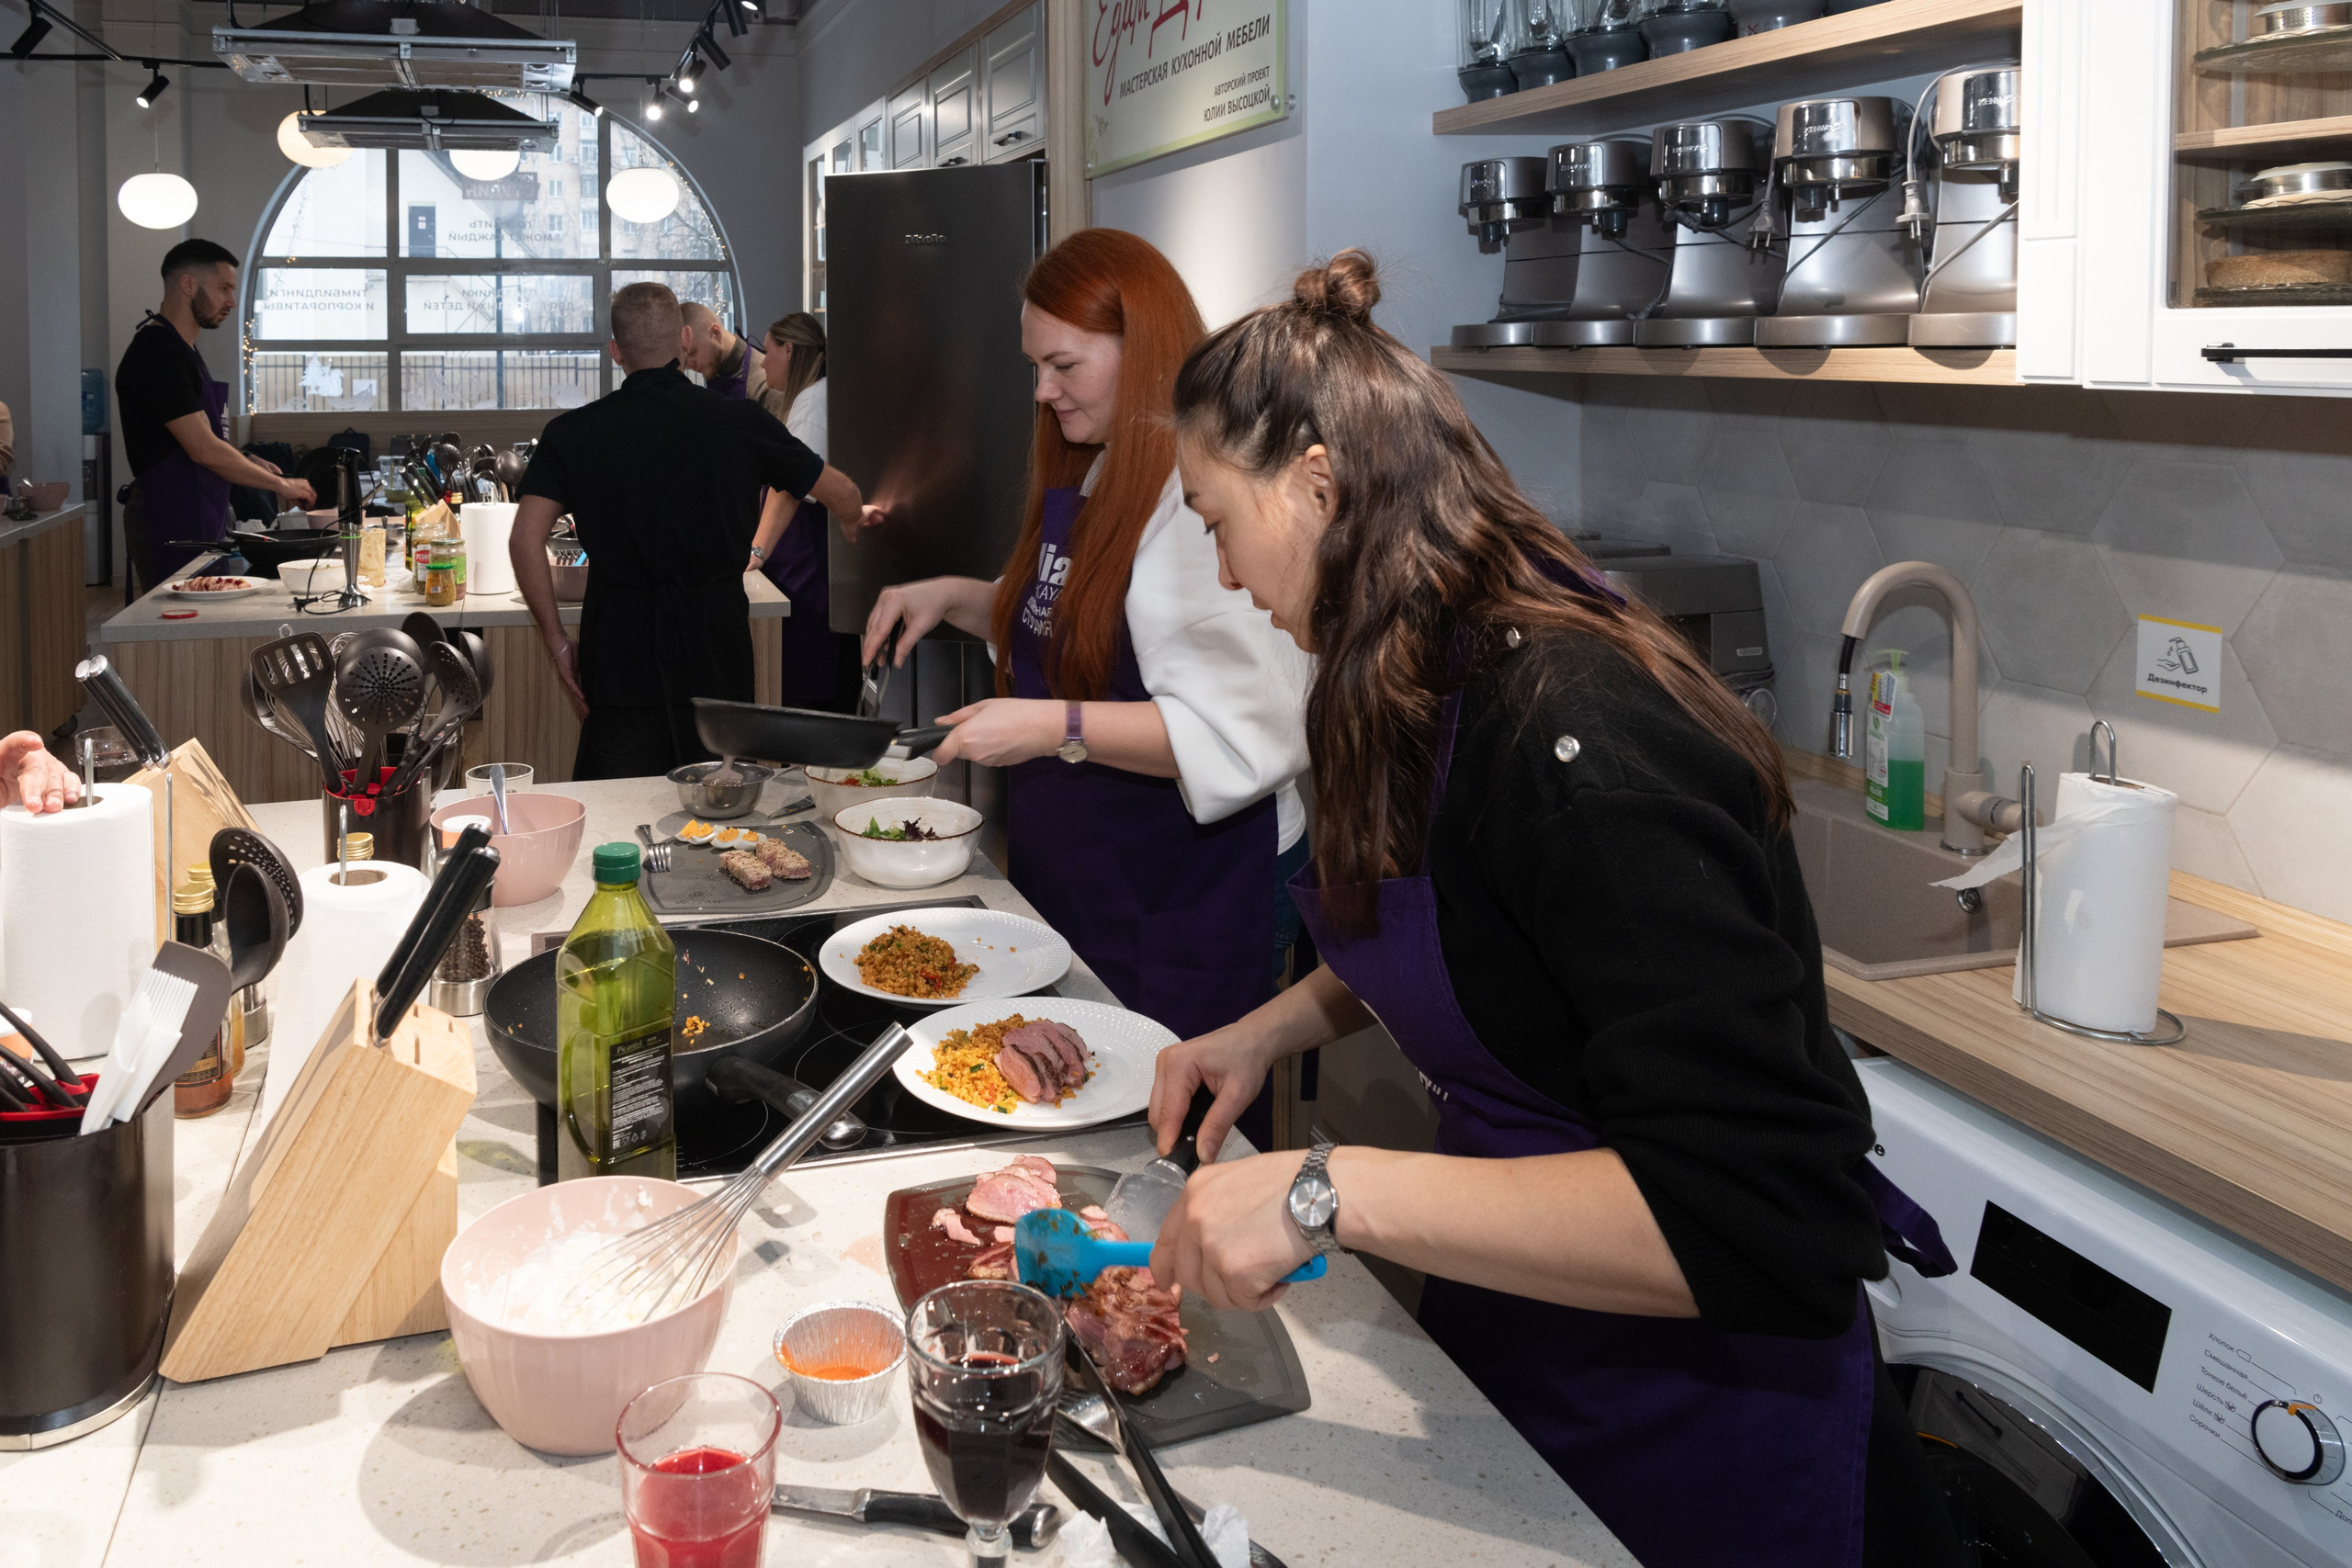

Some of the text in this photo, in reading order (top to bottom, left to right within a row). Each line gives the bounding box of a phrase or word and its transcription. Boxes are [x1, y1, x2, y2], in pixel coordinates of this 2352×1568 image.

[1120, 61, 1168, 98] МАСТЕРСКАЯ
[1171, 30, 1222, 75] КУХОННОЙ
[1227, 14, 1271, 51] МЕБЕЛИ
[1214, 66, 1271, 96] АВТОРСКИЙ ПРОЕКТ
[1204, 84, 1271, 122] ЮЛИИ ВЫСОЦКОЙ
[2147, 673, 2208, 694] Дезинфектор
[2208, 1332, 2234, 1352] Хлопок
[2204, 1349, 2248, 1380] Смешанная
[2196, 1382, 2224, 1405] Шерсть
[2200, 1366, 2248, 1400] Тонкое бельё
[2192, 1398, 2213, 1416] Шёлк
[2189, 1414, 2221, 1438] Сорочки
